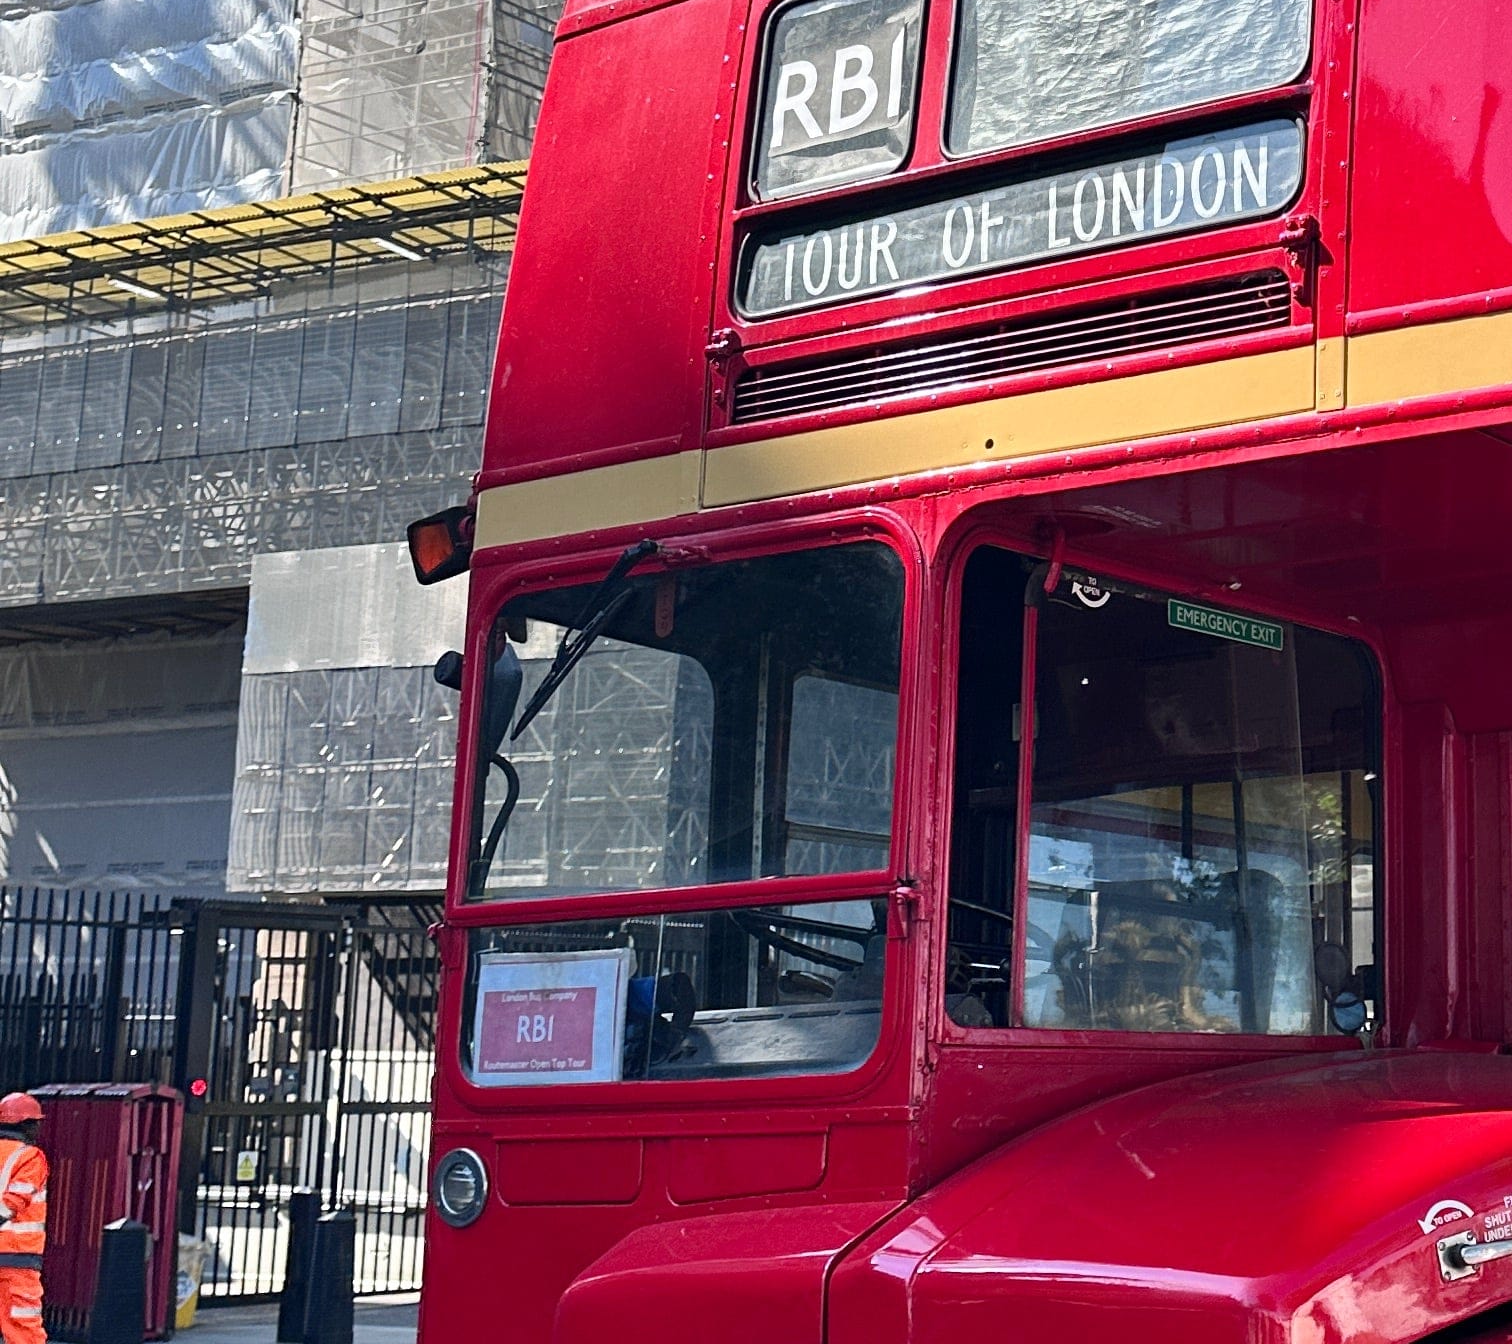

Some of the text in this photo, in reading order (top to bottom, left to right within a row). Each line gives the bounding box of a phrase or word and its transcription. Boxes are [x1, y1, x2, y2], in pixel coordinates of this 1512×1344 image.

[780, 136, 1269, 301] TOUR OF LONDON
[1176, 606, 1276, 643] EMERGENCY EXIT
[530, 1058, 551, 1070] Open
[551, 1058, 568, 1069] Top
[567, 1057, 586, 1068] Tour
[1433, 1210, 1463, 1226] TO OPEN
[1484, 1210, 1511, 1229] SHUT
